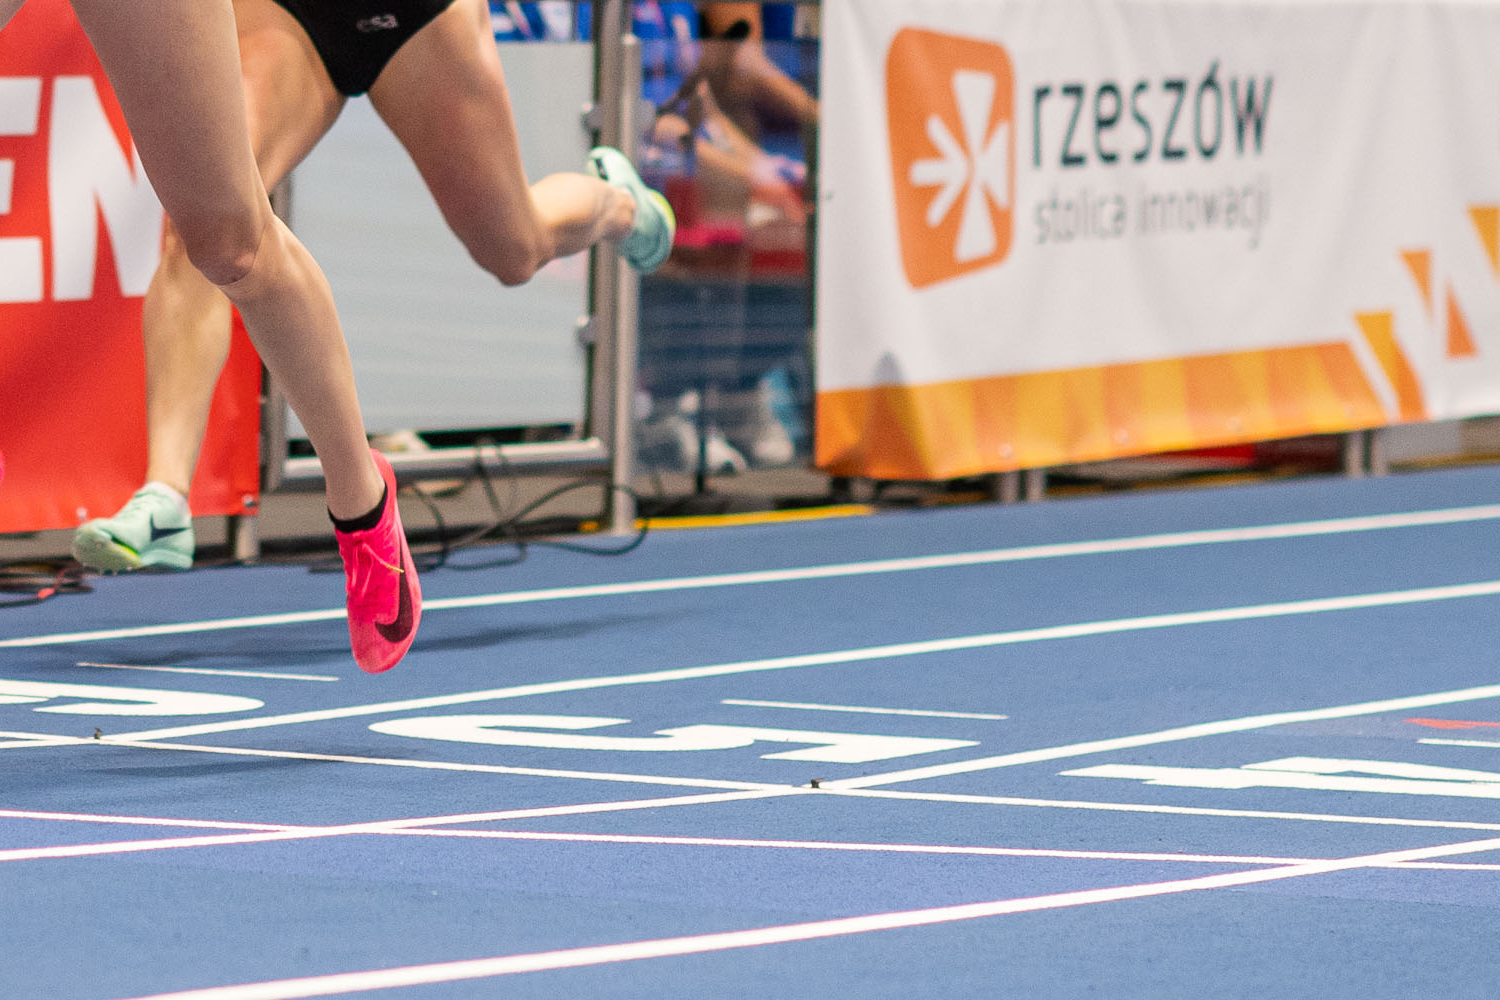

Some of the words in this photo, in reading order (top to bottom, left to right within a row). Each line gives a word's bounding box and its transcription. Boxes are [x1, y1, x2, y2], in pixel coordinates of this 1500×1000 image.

[1033, 59, 1273, 168] rzeszów
[1035, 187, 1125, 245] stolica
[1136, 176, 1271, 250] innowacji
